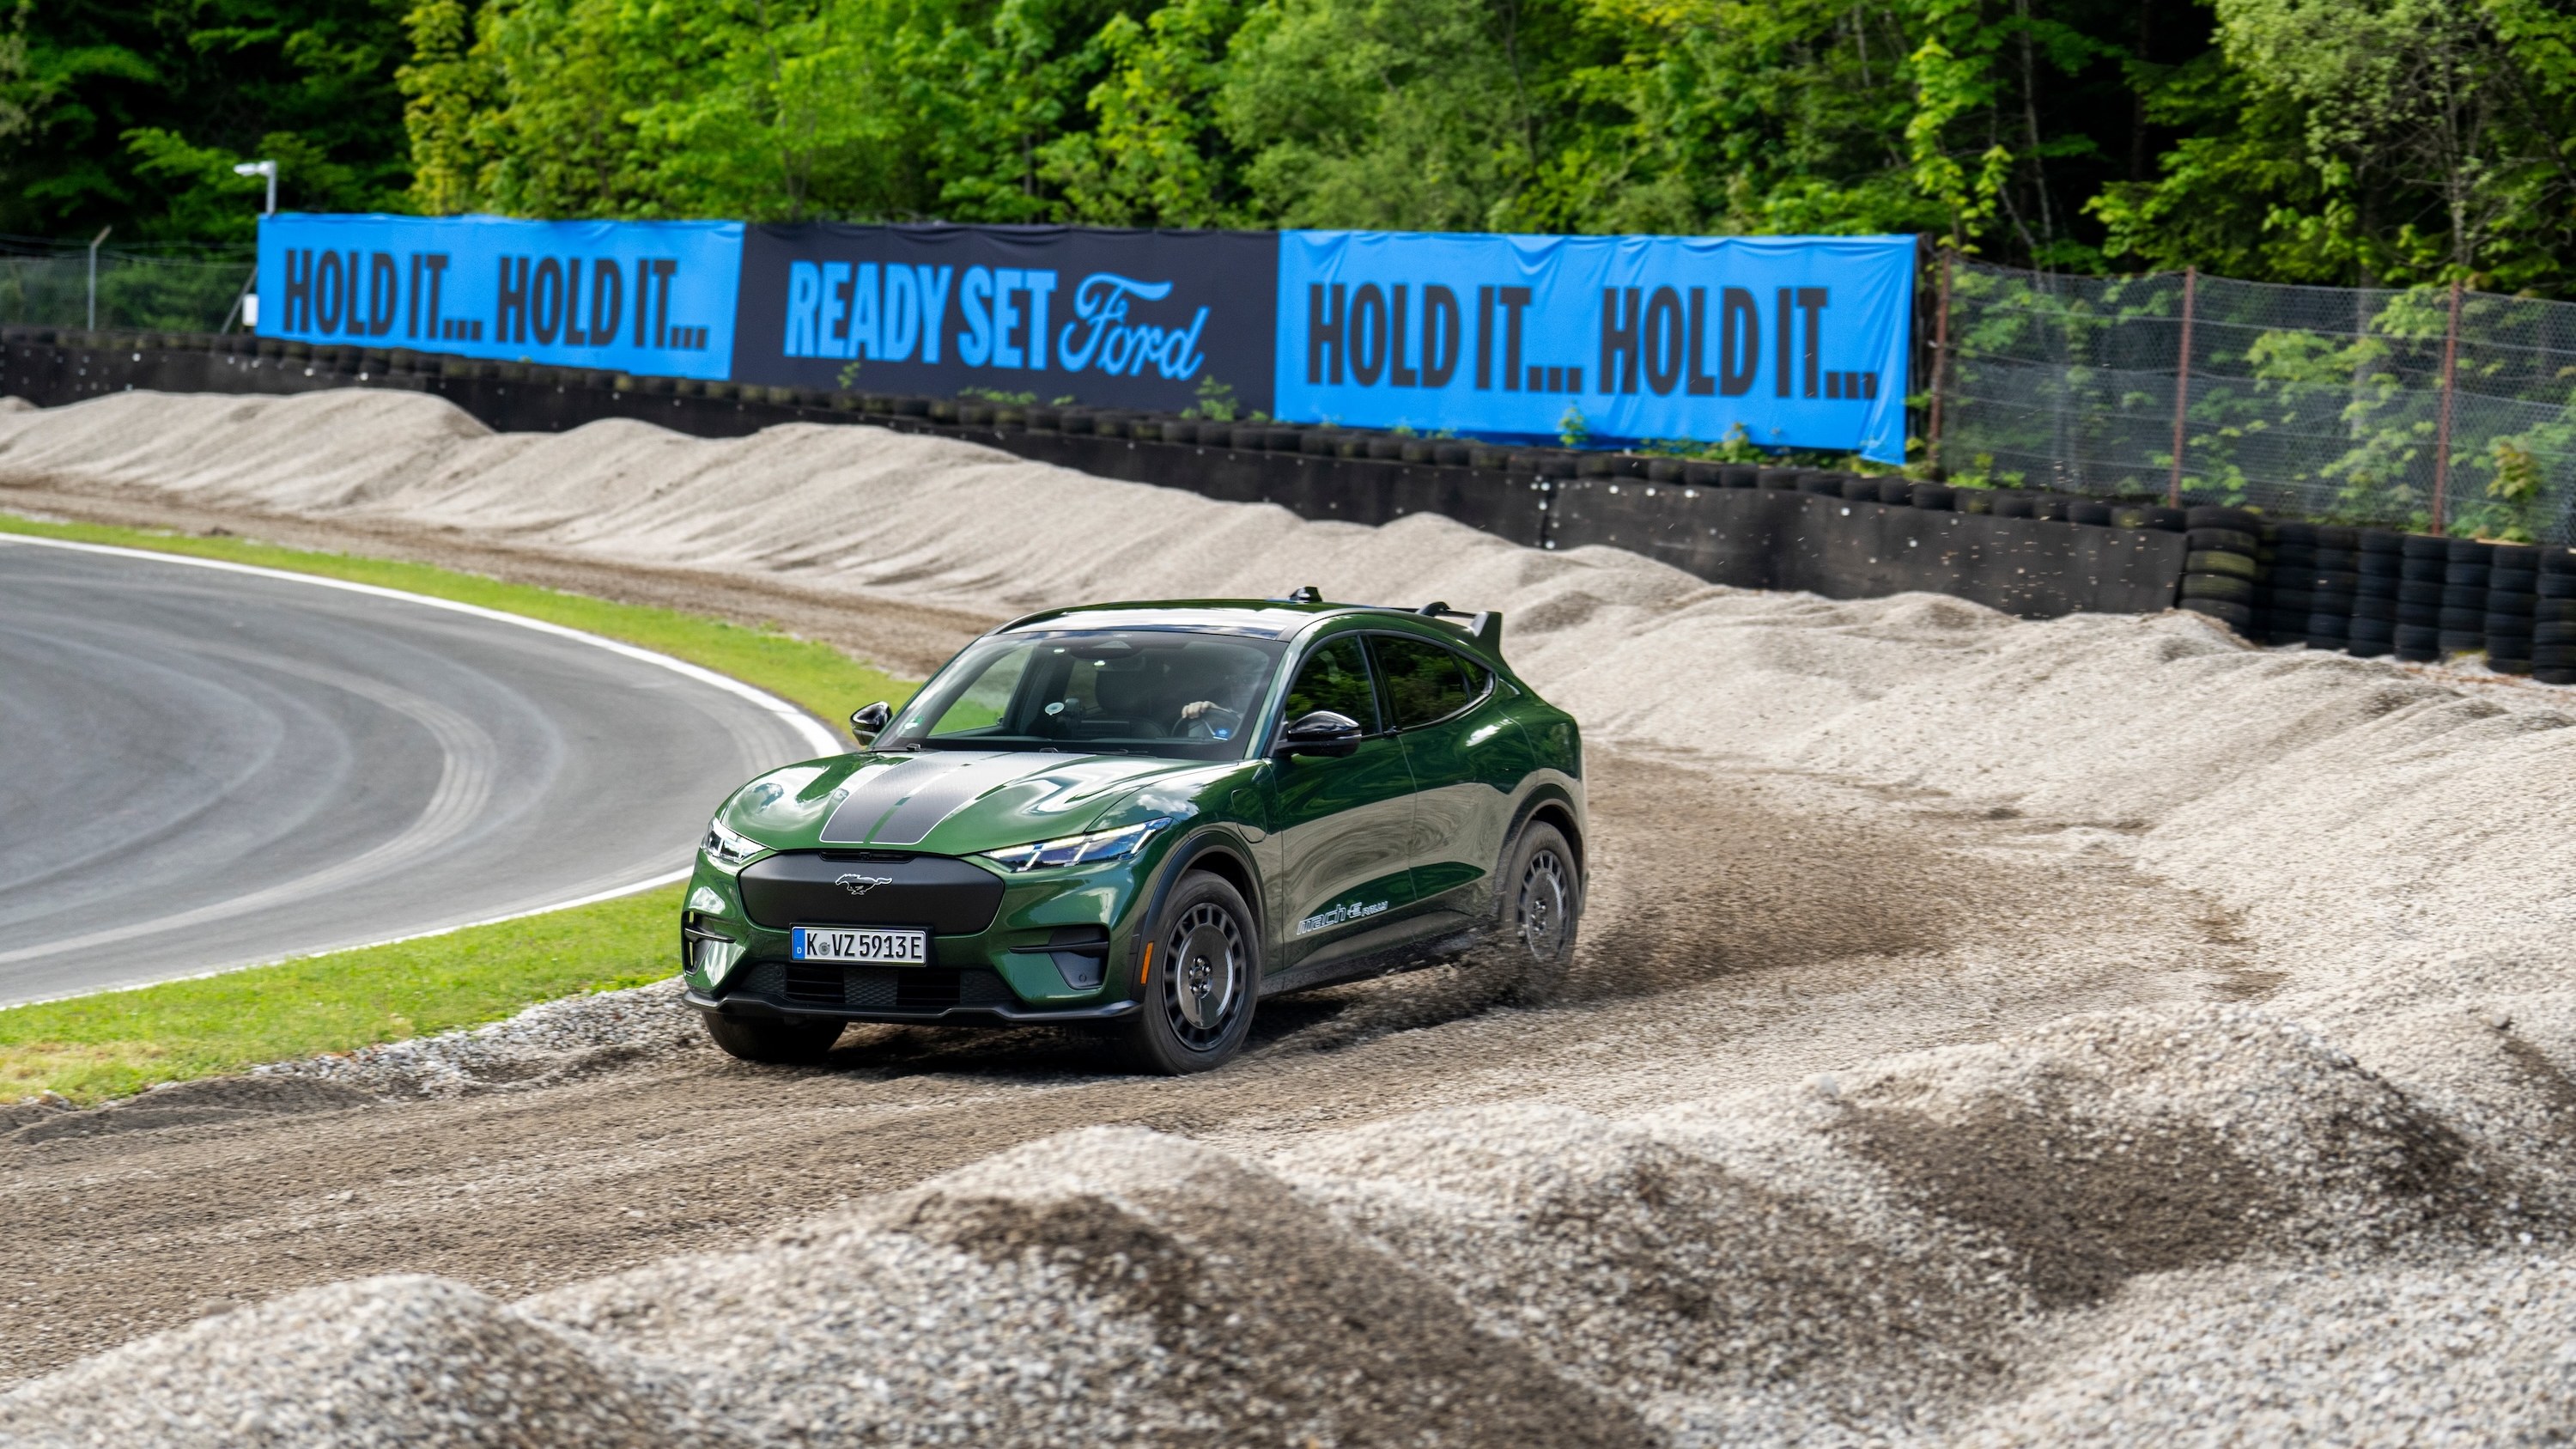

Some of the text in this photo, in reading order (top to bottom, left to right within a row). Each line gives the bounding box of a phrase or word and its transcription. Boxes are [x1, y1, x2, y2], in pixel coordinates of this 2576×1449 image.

[283, 248, 708, 350] HOLD IT... HOLD IT...
[783, 260, 1211, 381] READY SET Ford
[1307, 283, 1879, 400] HOLD IT... HOLD IT...
[806, 933, 817, 956] K
